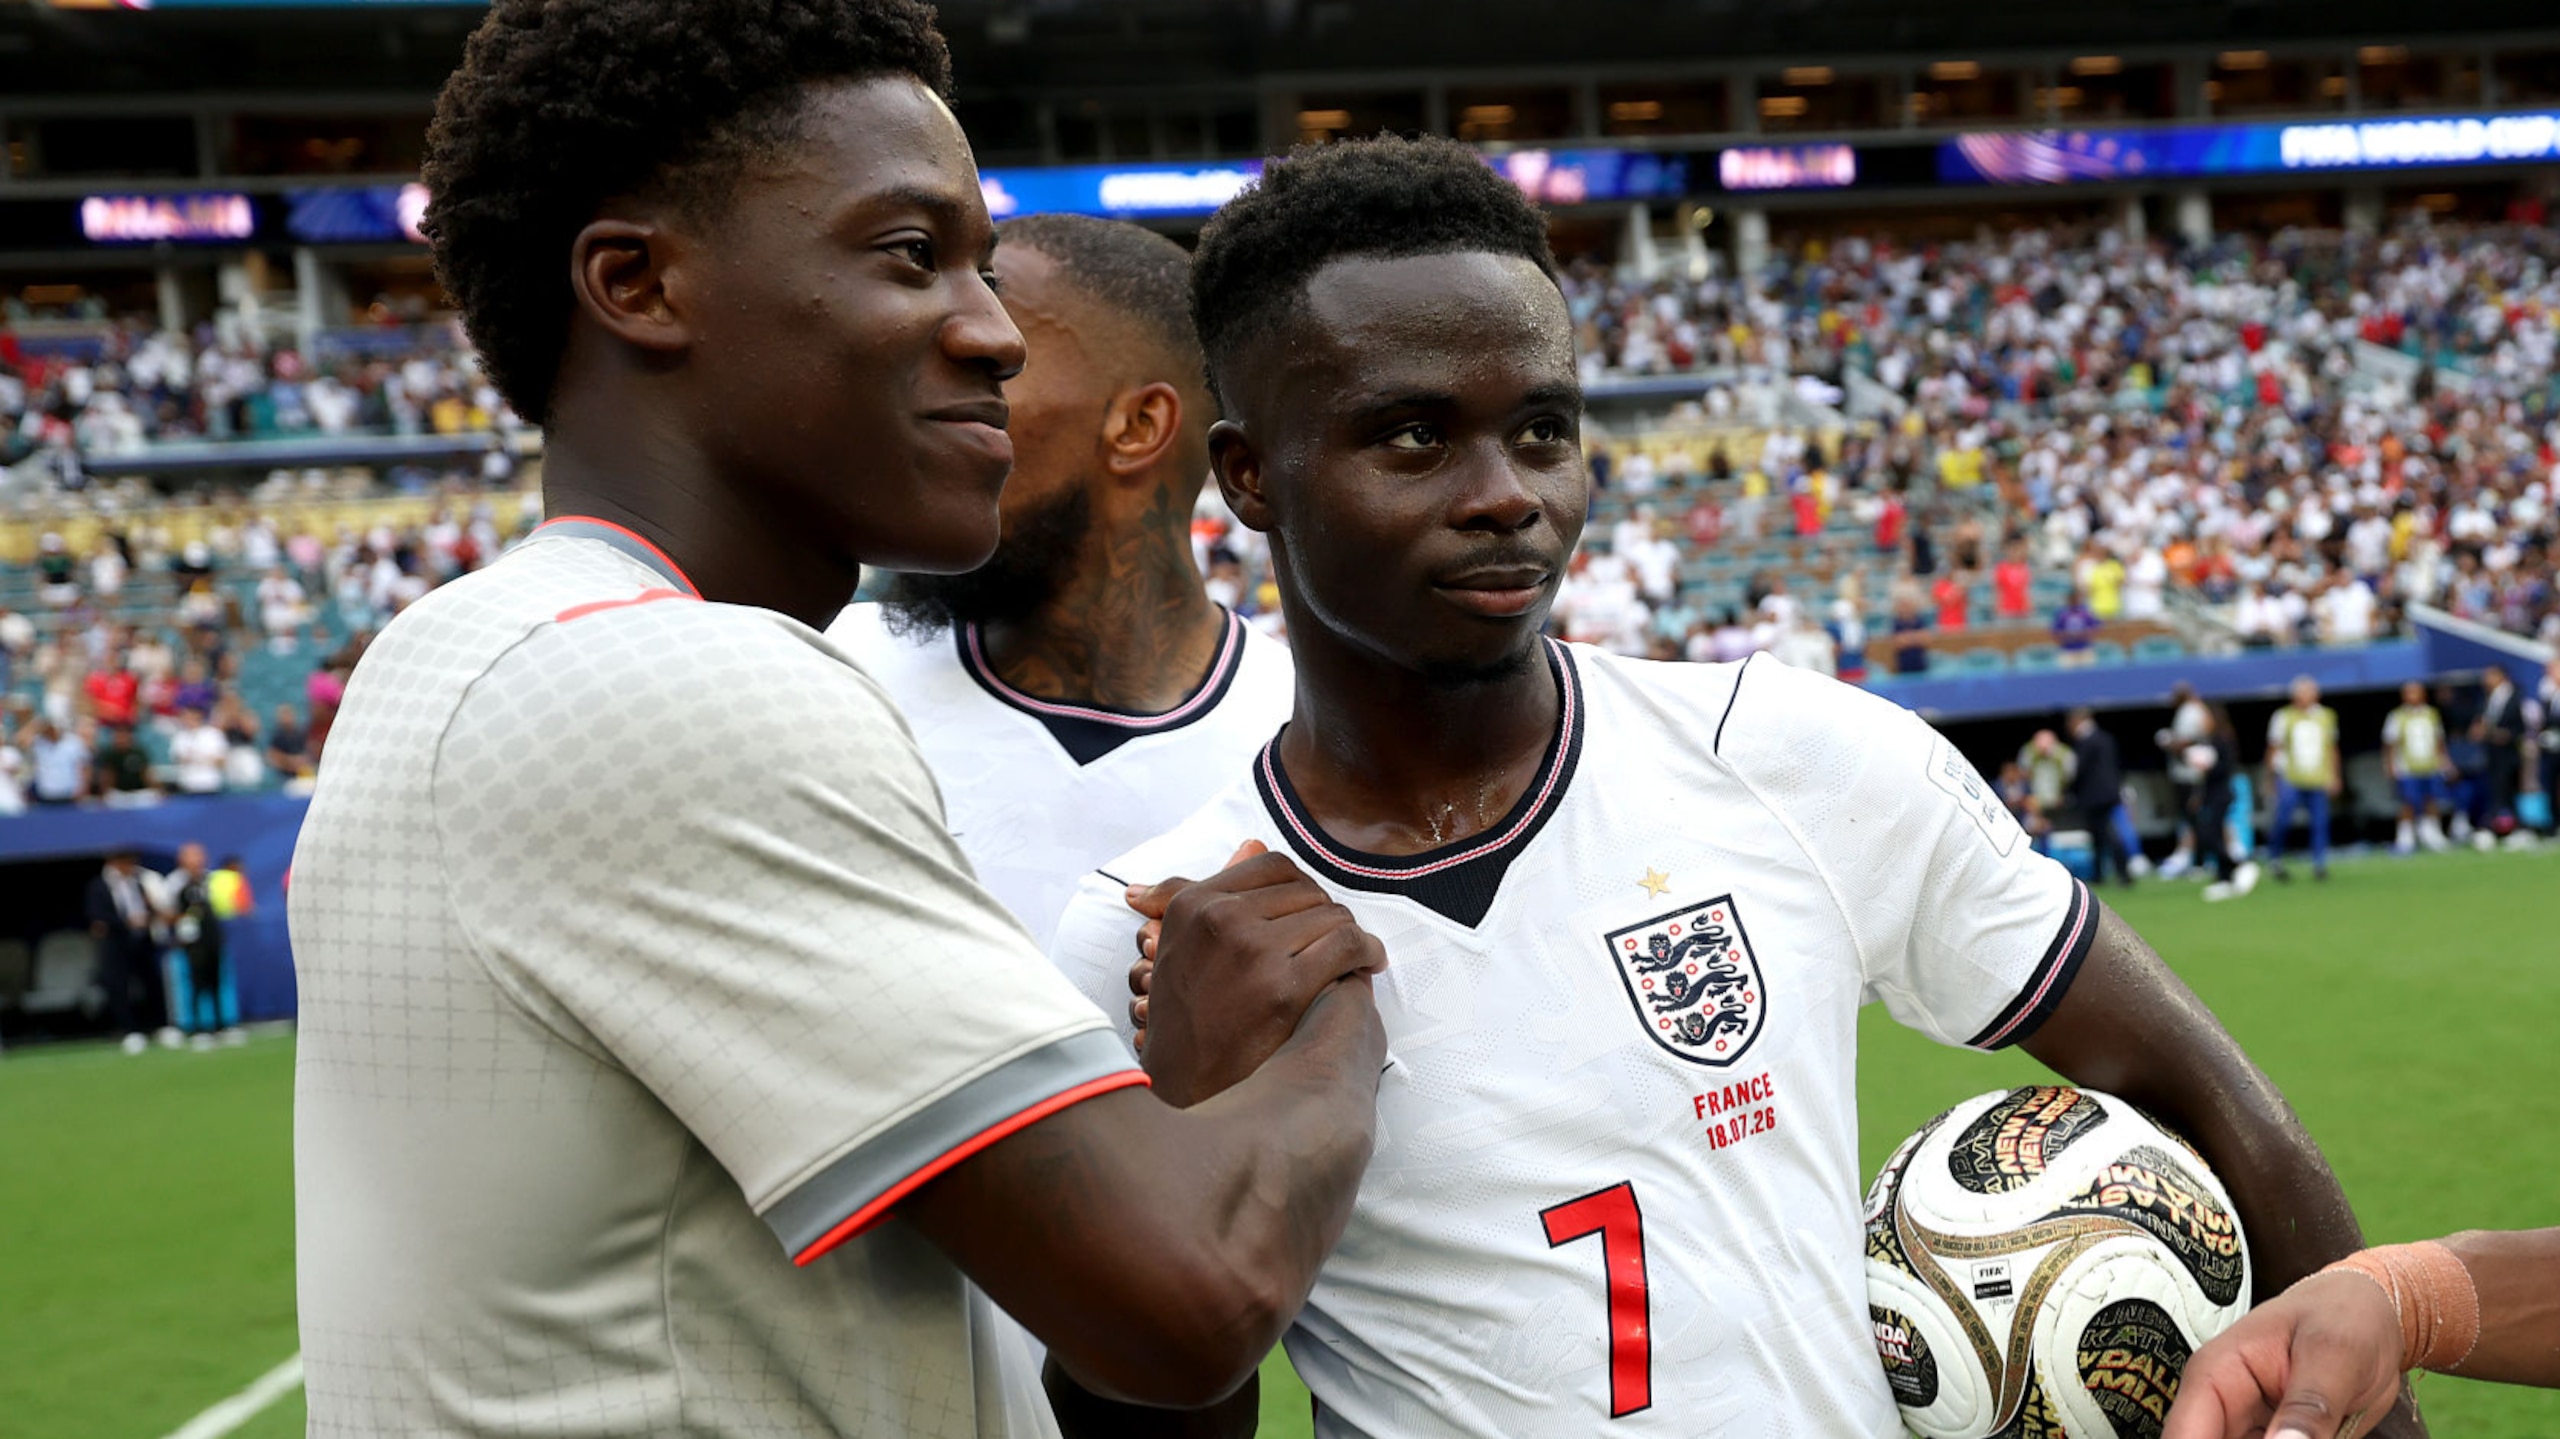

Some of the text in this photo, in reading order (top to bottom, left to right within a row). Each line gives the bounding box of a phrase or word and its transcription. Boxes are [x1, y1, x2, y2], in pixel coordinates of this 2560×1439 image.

[1693, 1071, 1774, 1121] FRANCE
[1705, 1107, 1776, 1152] 18.07.26
[2099, 1184, 2234, 1256] DALLAS
[1540, 1180, 1652, 1418] 7
[2085, 1369, 2165, 1422] MIA
